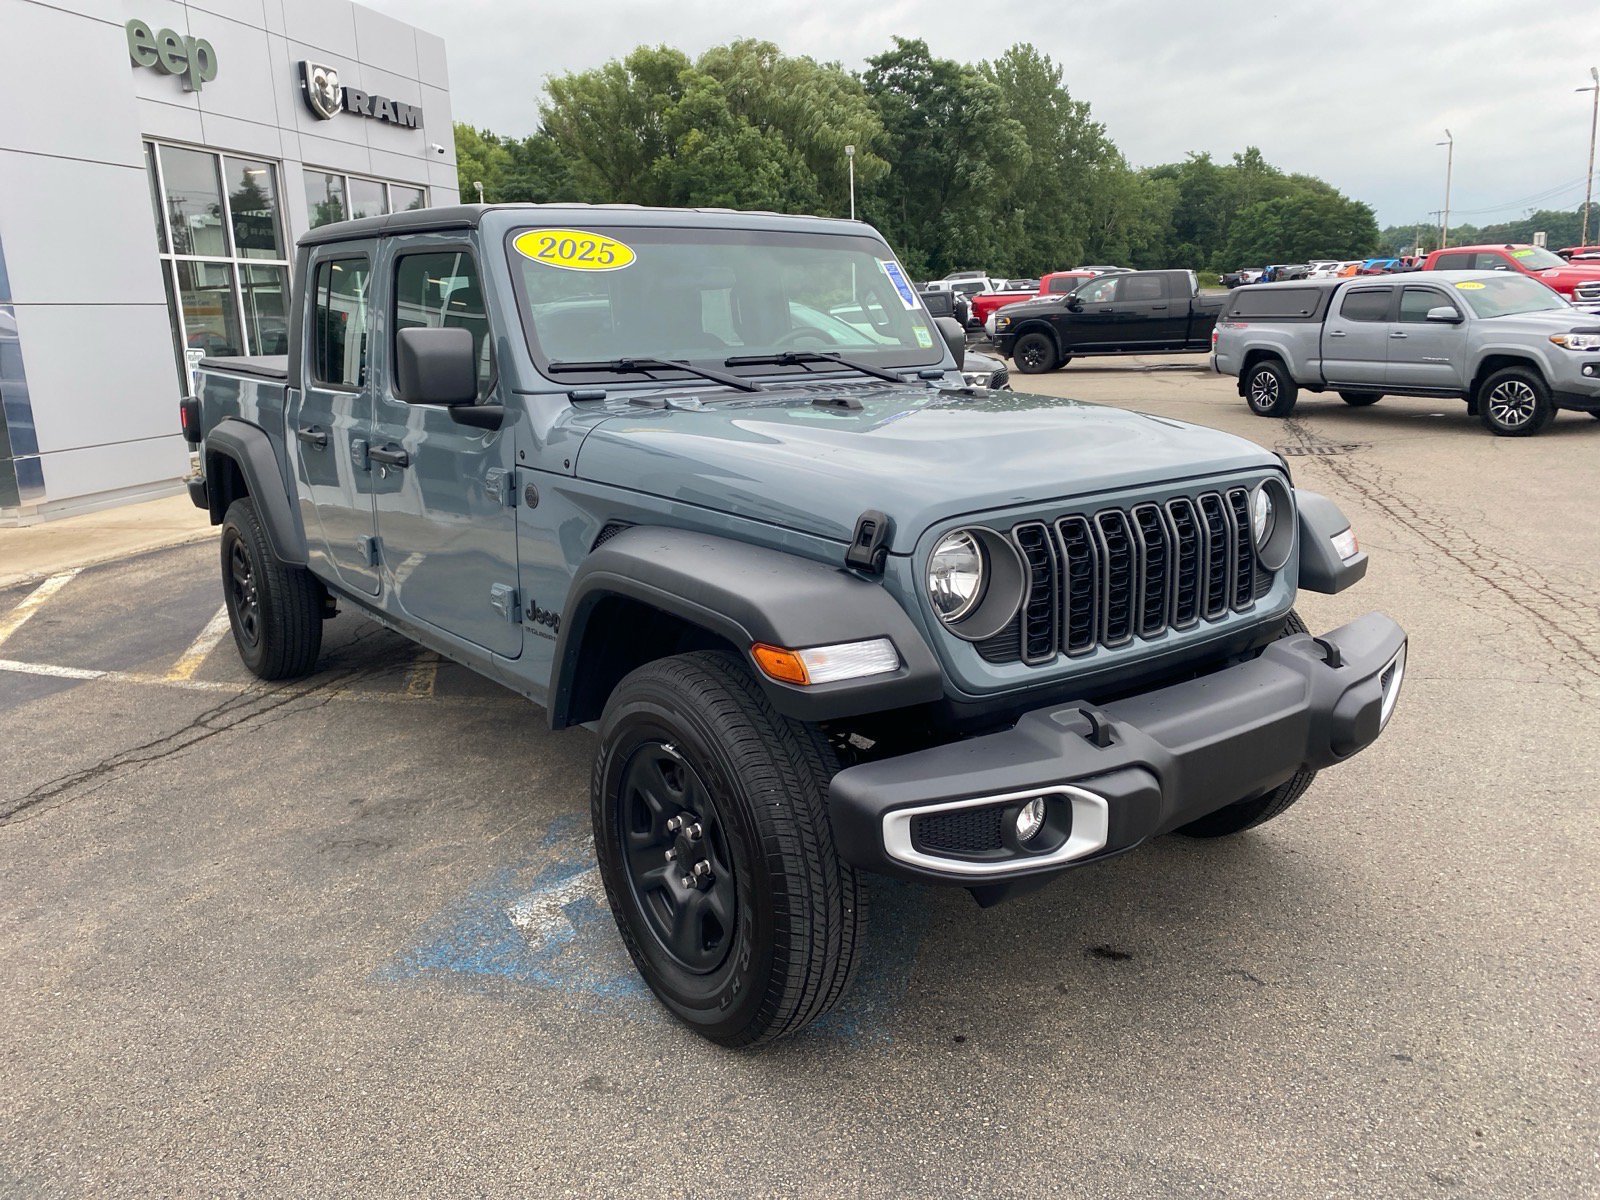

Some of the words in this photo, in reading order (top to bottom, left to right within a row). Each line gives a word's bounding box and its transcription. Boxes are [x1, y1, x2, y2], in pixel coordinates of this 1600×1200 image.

[126, 18, 218, 92] eep
[341, 86, 424, 129] RAM
[538, 236, 615, 265] 2025
[526, 599, 561, 634] Jeep
